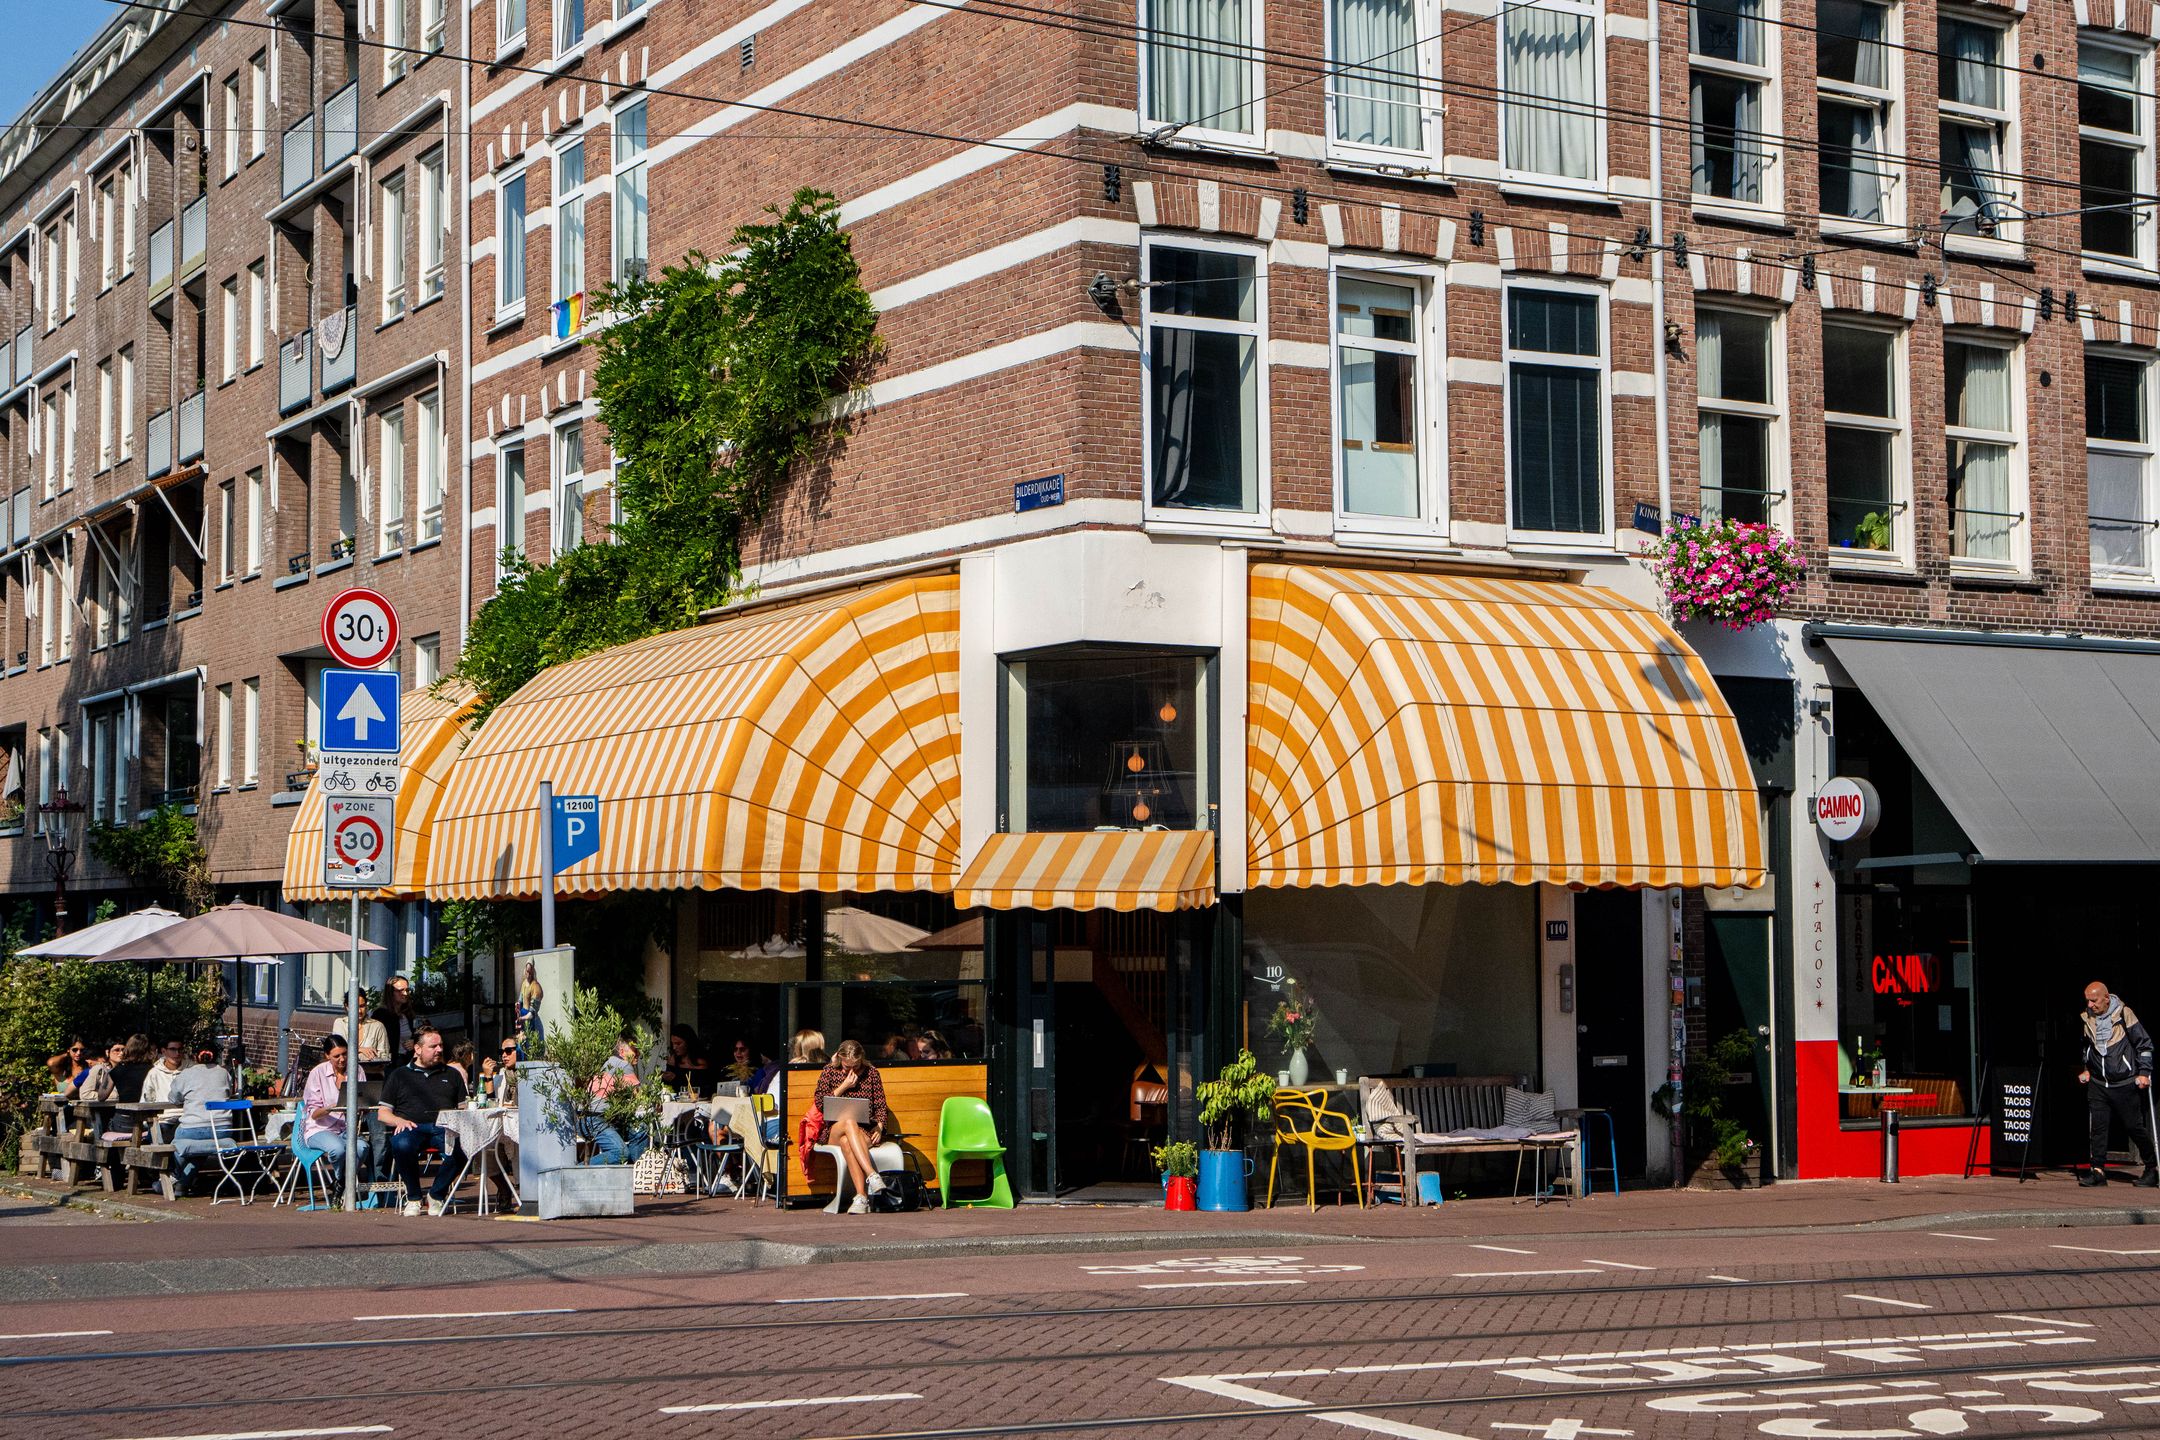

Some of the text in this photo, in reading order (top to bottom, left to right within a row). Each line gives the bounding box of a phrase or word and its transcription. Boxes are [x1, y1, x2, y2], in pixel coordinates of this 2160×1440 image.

[1016, 478, 1060, 498] BILDERDIJKKADE
[323, 755, 398, 767] uitgezonderd
[345, 803, 375, 811] ZONE
[566, 801, 594, 810] 12100
[1819, 794, 1861, 819] CAMINO
[567, 817, 585, 847] P
[344, 832, 375, 850] 30
[1550, 923, 1567, 935] 110
[1813, 899, 1823, 989] TACOS
[1266, 965, 1283, 978] 110
[2003, 1085, 2031, 1095] TACOS
[2003, 1097, 2031, 1107] TACOS
[2003, 1108, 2031, 1119] TACOS
[2003, 1120, 2031, 1131] TACOS
